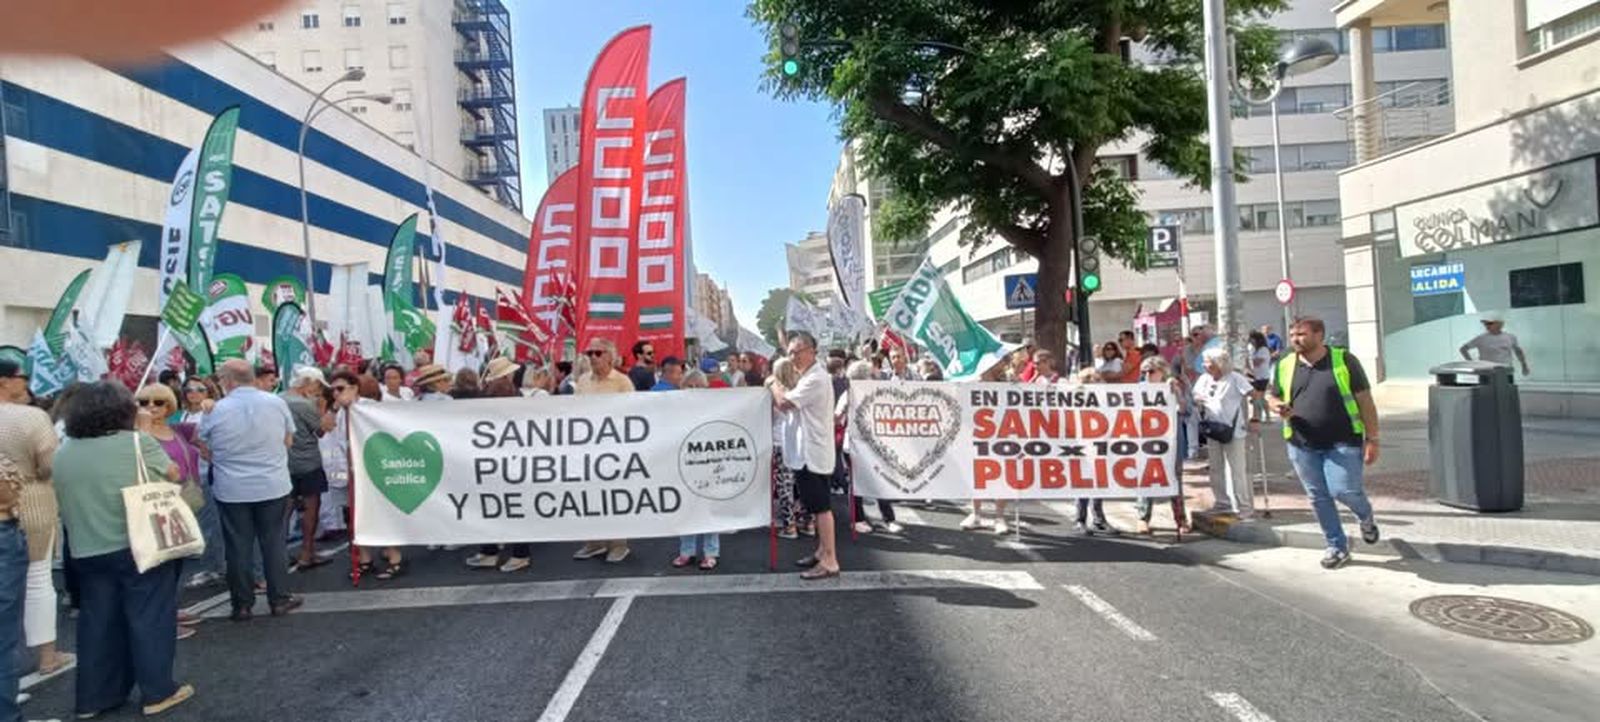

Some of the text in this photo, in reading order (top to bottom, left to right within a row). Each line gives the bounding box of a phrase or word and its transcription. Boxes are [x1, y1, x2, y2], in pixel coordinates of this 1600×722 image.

[589, 87, 636, 279] CCOO
[638, 129, 676, 293] CCOO
[1415, 209, 1536, 252] COLMAN
[1411, 278, 1458, 292] ALIDA
[874, 404, 941, 420] MAREA
[971, 390, 1168, 408] EN DEFENSA DE LA
[472, 415, 650, 450] SANIDAD
[875, 420, 941, 437] BLANCA
[972, 408, 1170, 440] SANIDAD
[687, 437, 747, 454] MAREA
[973, 440, 1051, 457] 100
[1093, 439, 1170, 457] 100
[474, 451, 650, 485] PÚBLICA
[973, 452, 1169, 491] PÚBLICA
[448, 486, 682, 521] Y DE CALIDAD
